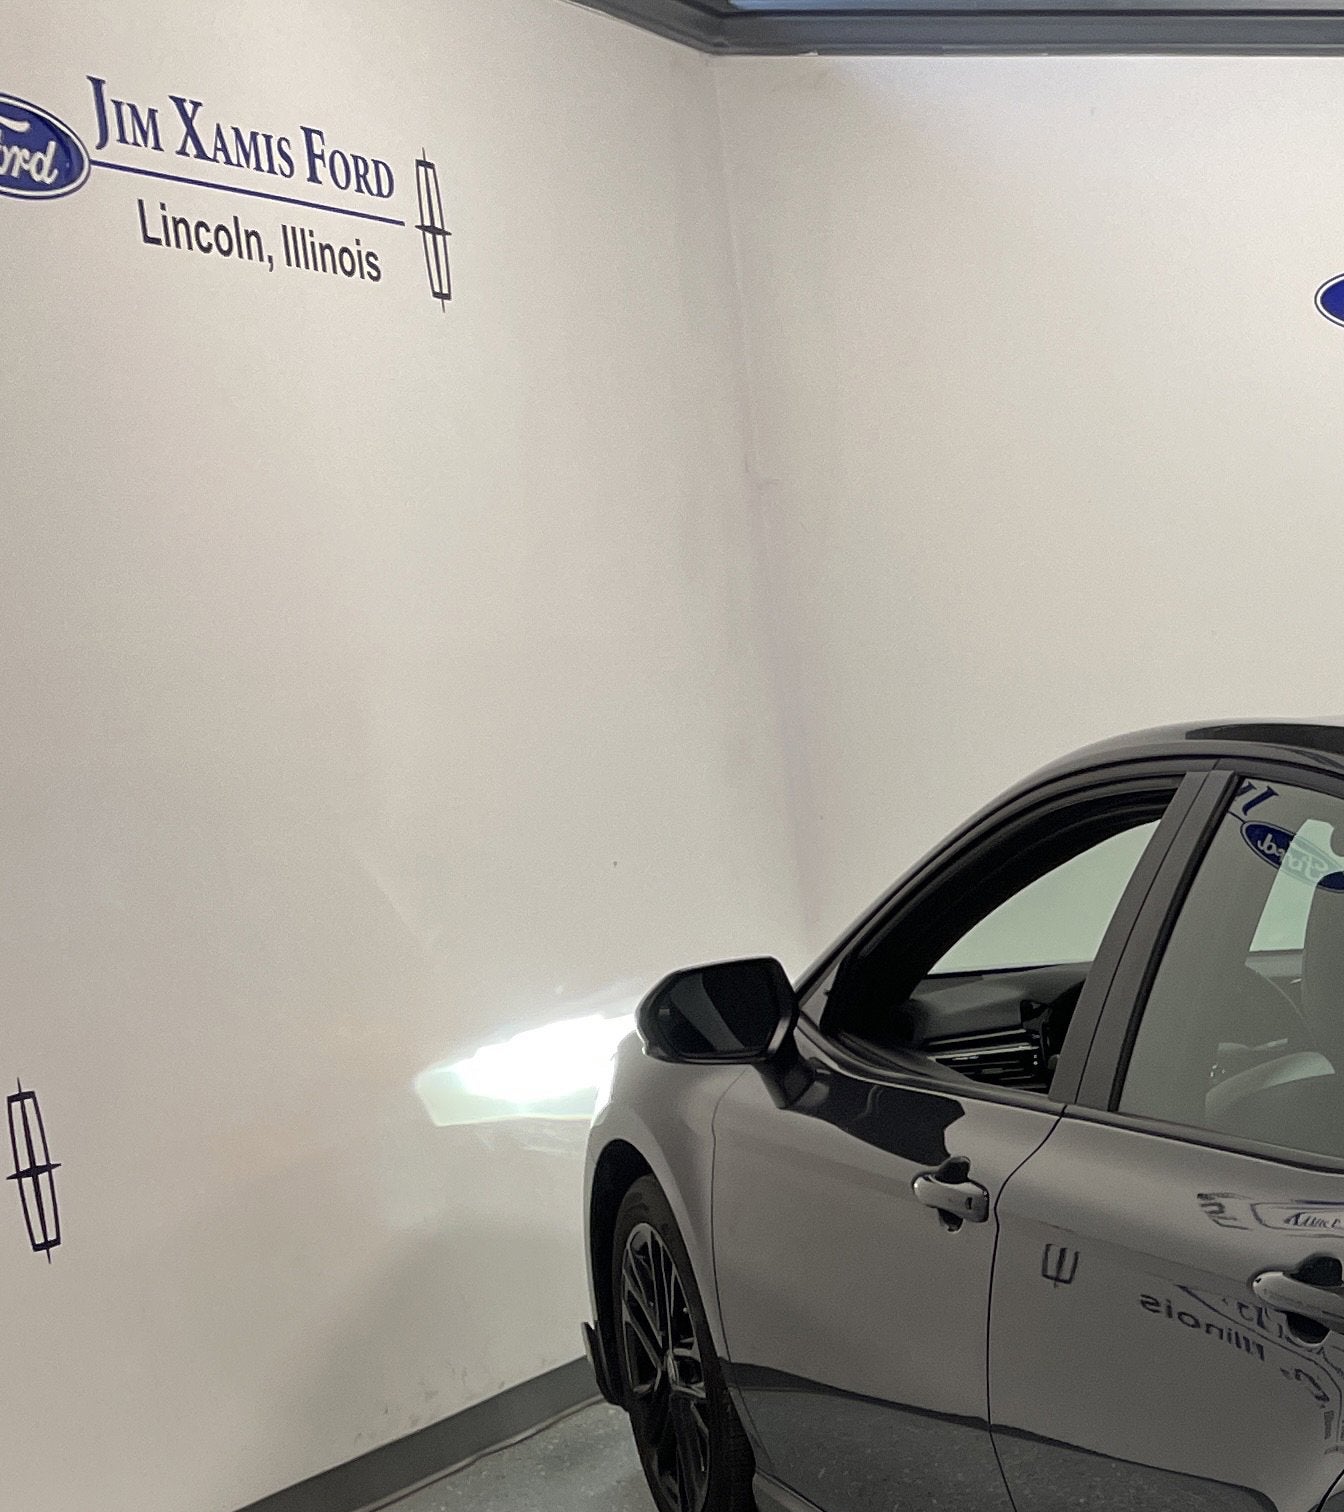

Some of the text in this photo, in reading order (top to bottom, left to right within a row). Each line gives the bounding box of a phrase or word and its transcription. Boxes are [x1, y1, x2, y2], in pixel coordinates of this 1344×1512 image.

[86, 75, 395, 199] JIM XAMIS FORD
[137, 198, 382, 282] Lincoln, Illinois
